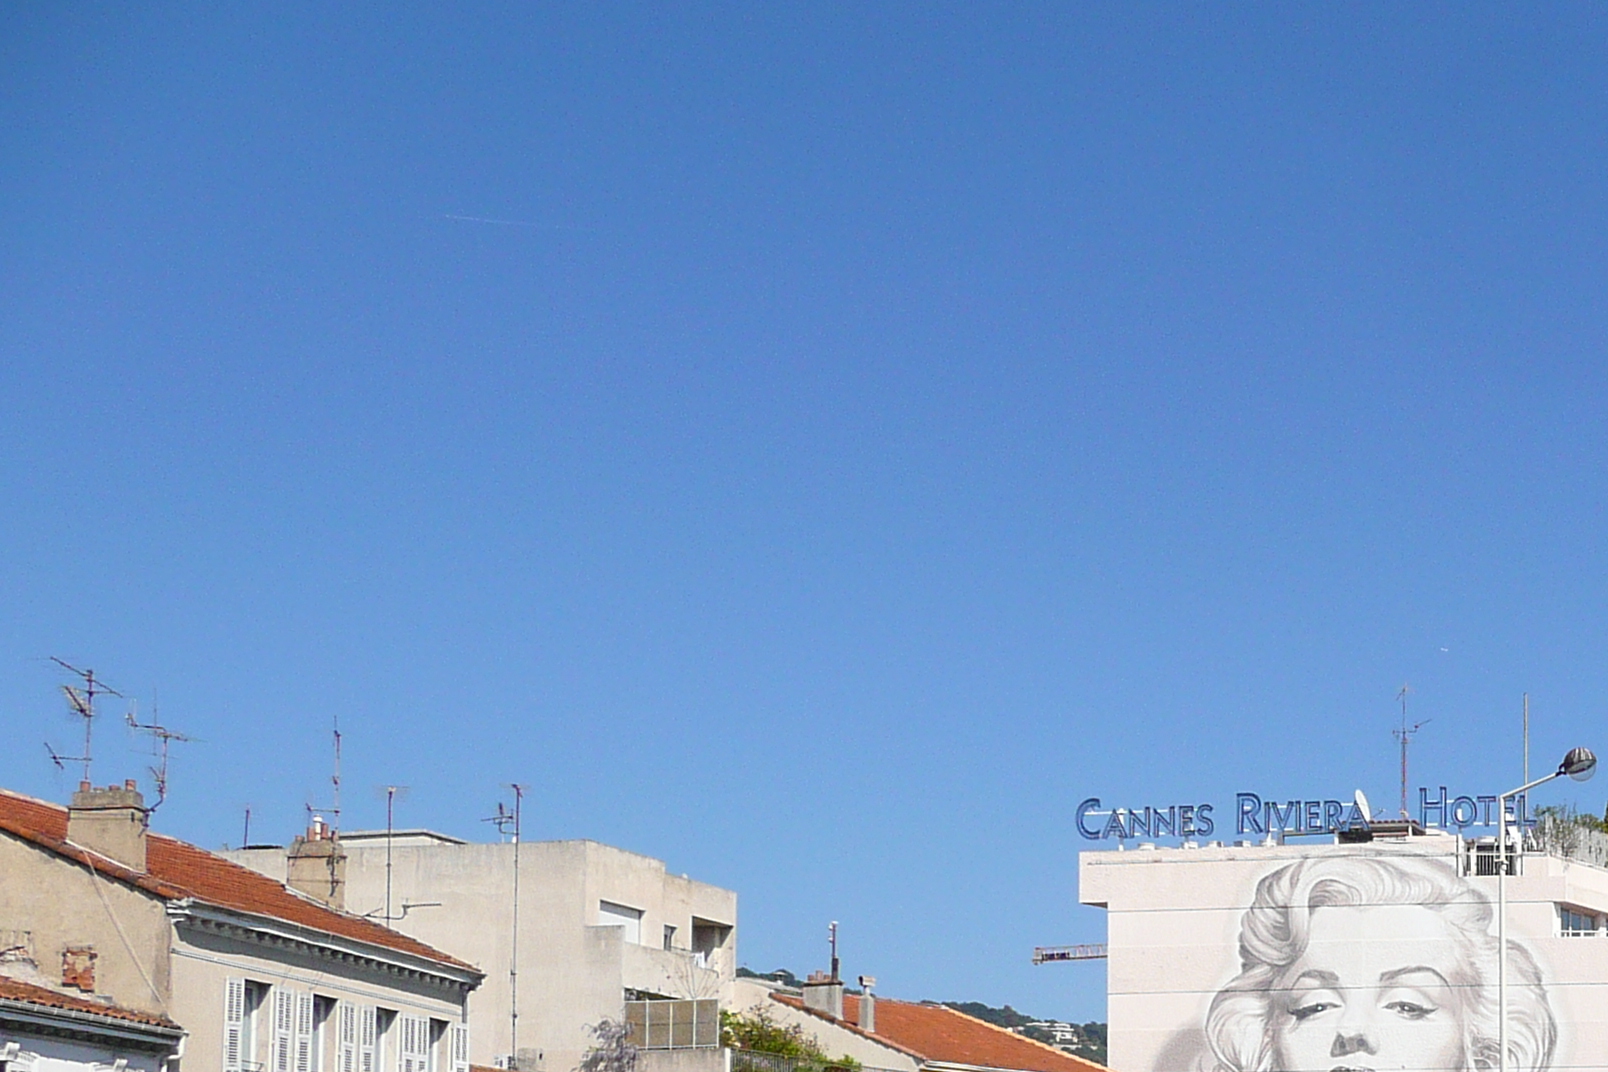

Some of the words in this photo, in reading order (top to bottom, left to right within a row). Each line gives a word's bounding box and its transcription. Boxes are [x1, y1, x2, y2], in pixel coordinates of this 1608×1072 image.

[1076, 798, 1214, 840] CANNES
[1236, 792, 1370, 835] RIVIERA
[1419, 786, 1537, 828] HOTEL
